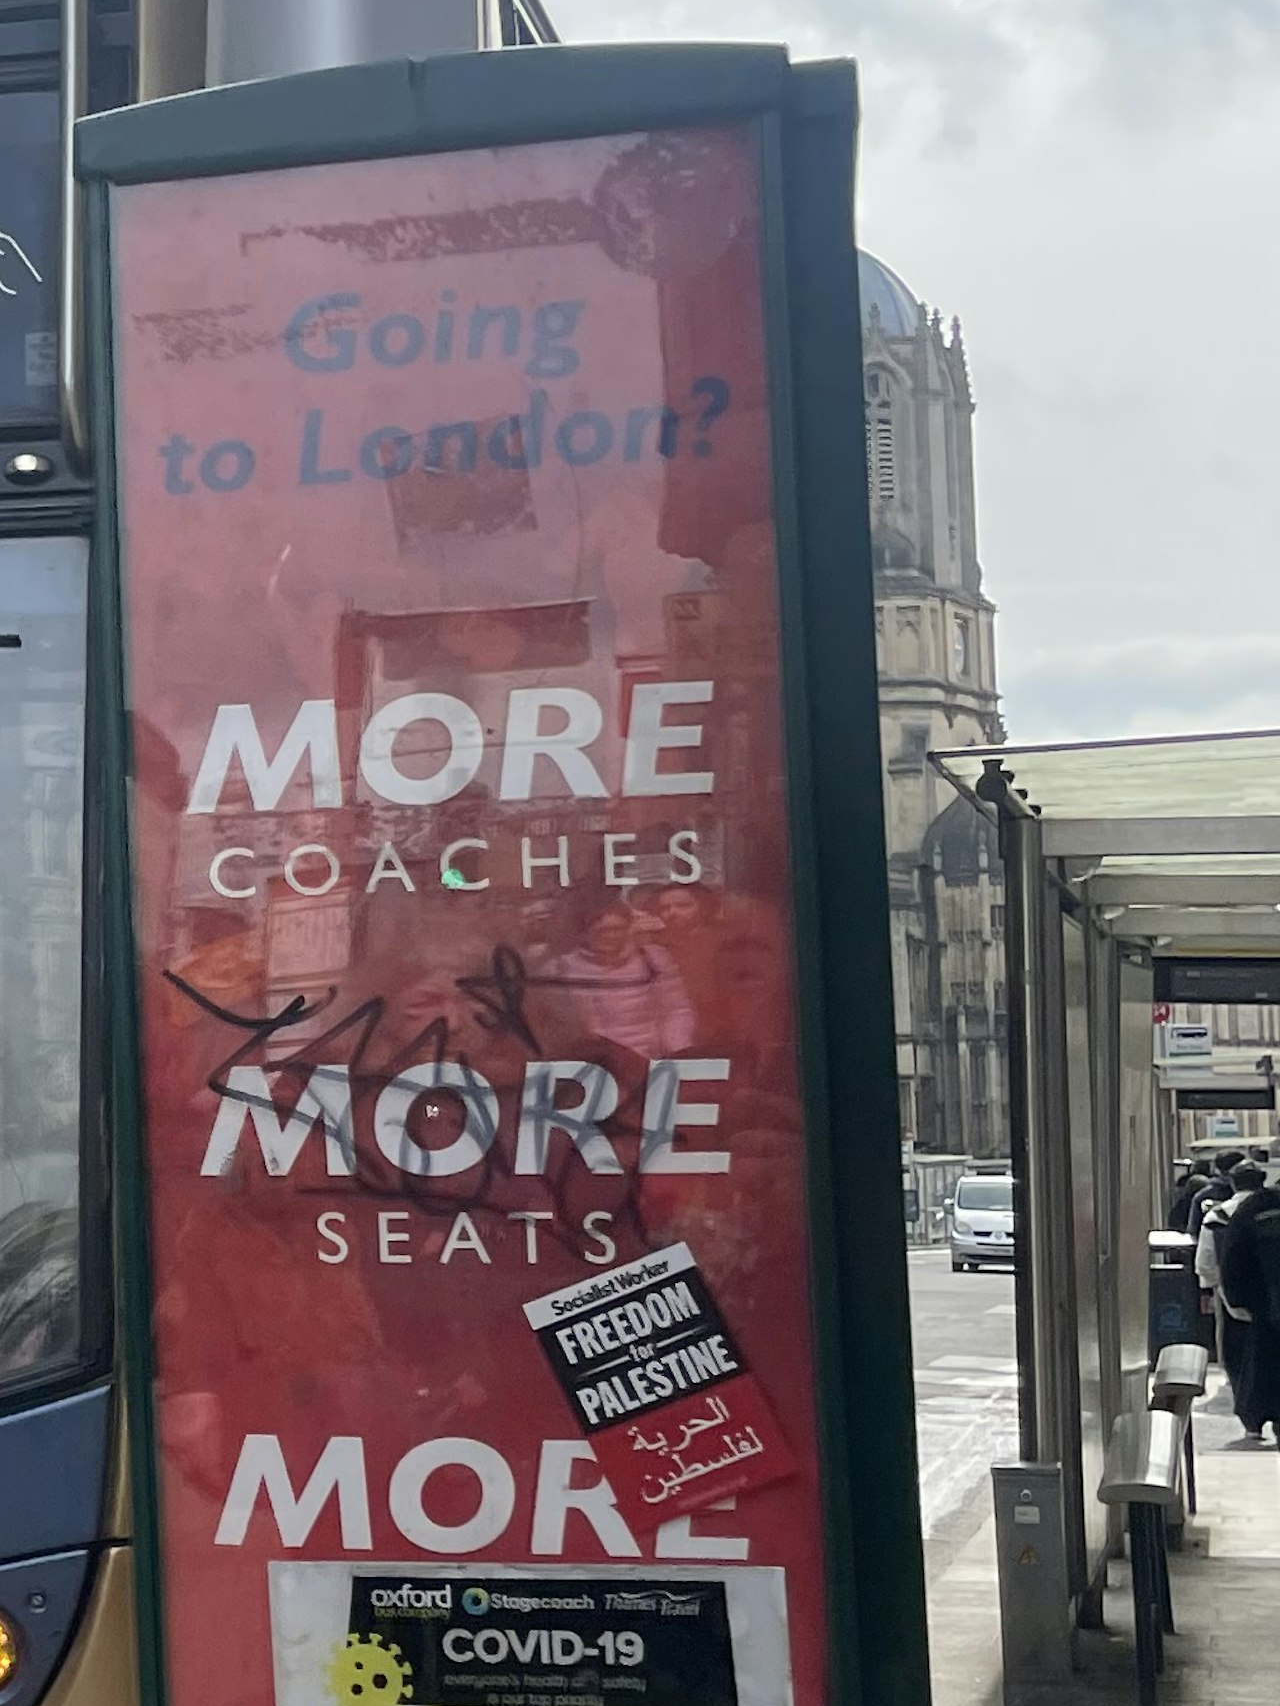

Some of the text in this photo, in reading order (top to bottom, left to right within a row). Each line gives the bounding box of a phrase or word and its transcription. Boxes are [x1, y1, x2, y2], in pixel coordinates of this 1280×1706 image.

[284, 291, 586, 377] Going
[158, 376, 731, 495] to London?
[186, 681, 715, 816] MORE
[209, 830, 703, 899] COACHES
[200, 1058, 732, 1177] MORE
[317, 1211, 617, 1265] SEATS
[551, 1260, 669, 1316] Socialist Worker
[555, 1281, 701, 1365] FREEDOM
[629, 1342, 657, 1362] for
[576, 1334, 738, 1425] PALESTINE
[627, 1395, 730, 1455] الحرية
[640, 1425, 764, 1503] لفلسطين
[371, 1583, 452, 1609] oxford
[490, 1593, 595, 1613] Stagecoach
[442, 1628, 645, 1667] COVID-19
